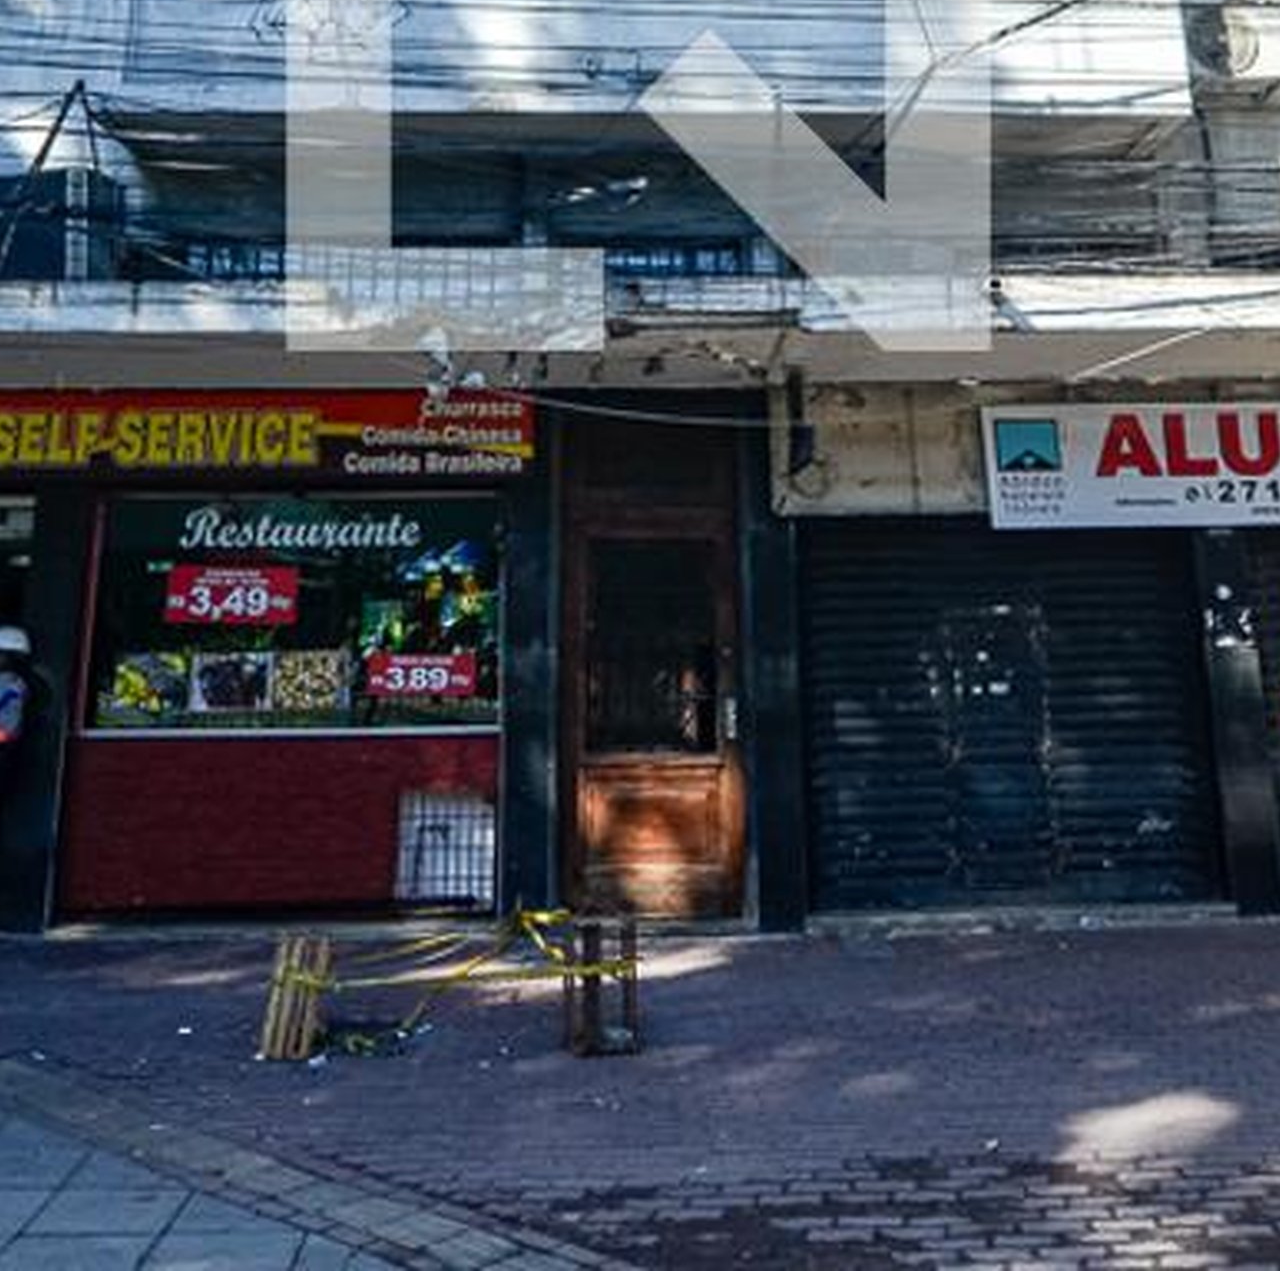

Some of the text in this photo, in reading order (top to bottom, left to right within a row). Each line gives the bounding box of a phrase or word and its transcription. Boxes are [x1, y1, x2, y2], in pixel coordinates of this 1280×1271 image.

[344, 452, 419, 473] Comida
[179, 509, 421, 550] Restaurante
[189, 585, 269, 619] 3,49
